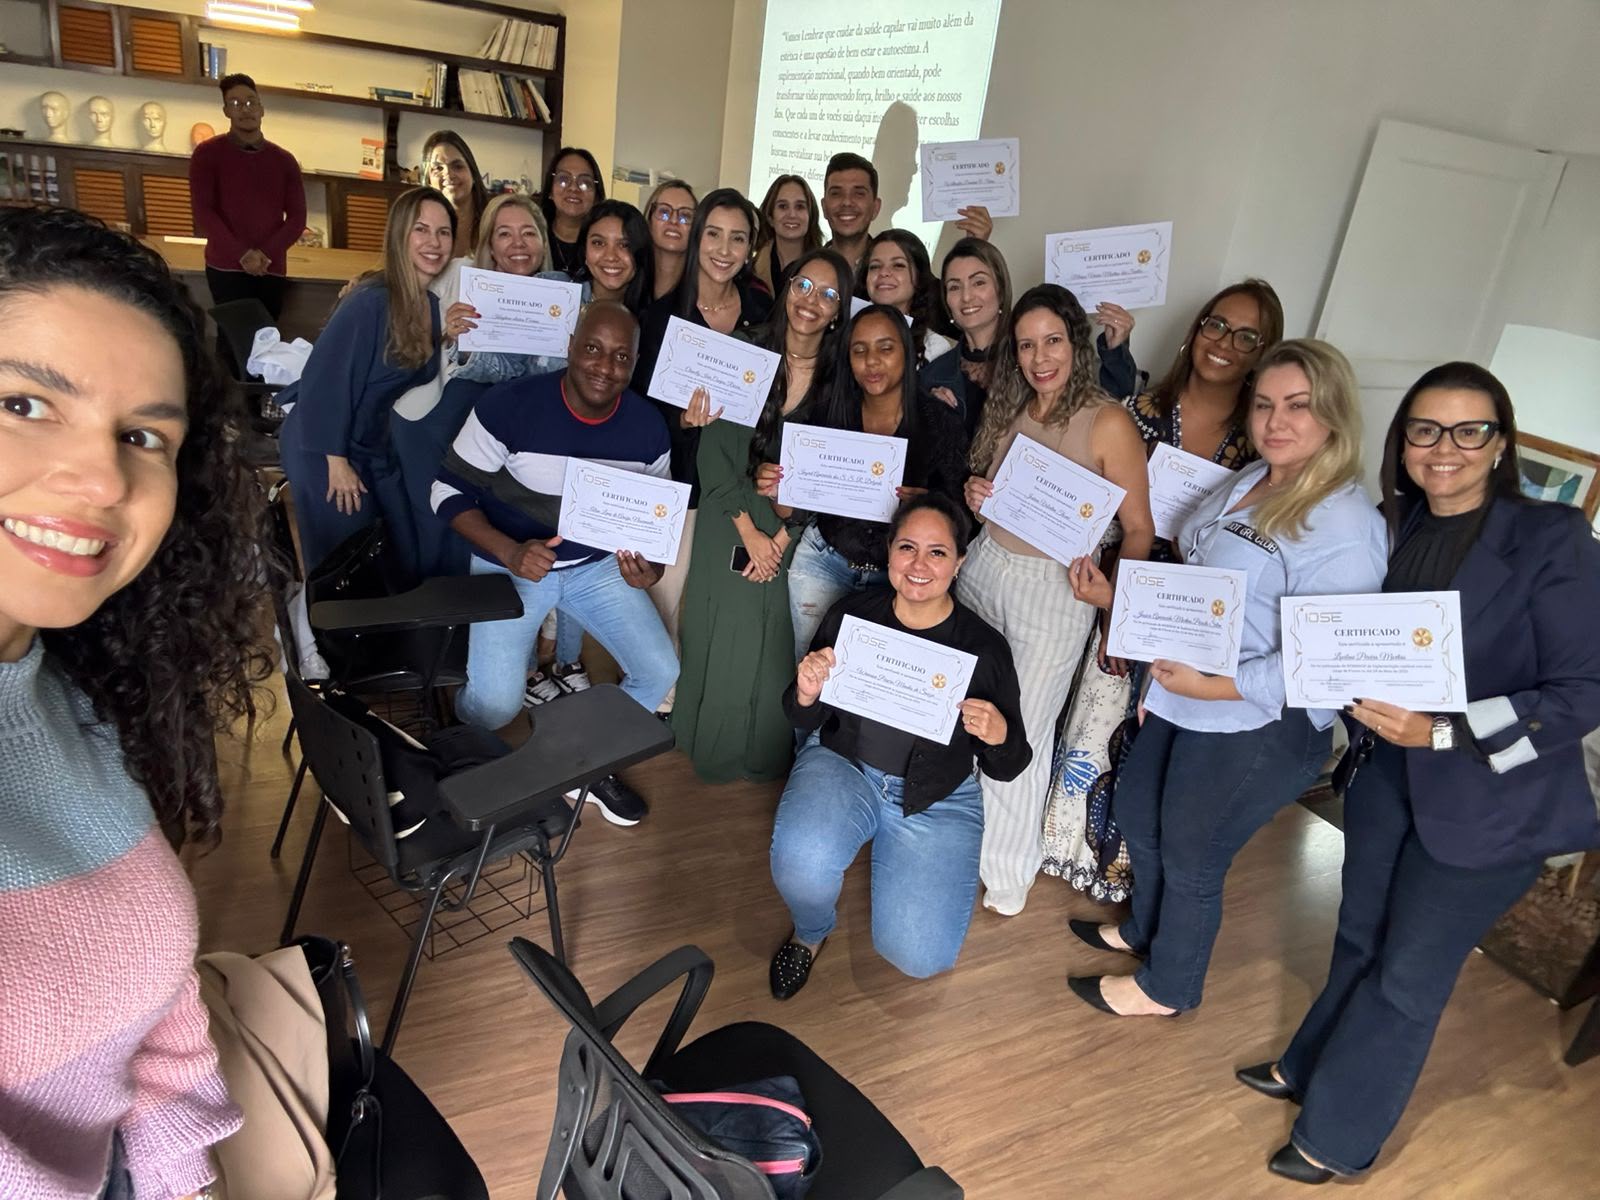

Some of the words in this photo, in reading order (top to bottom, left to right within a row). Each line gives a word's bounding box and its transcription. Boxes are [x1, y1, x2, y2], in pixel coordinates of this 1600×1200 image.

[825, 30, 836, 44] que
[855, 23, 863, 36] da
[864, 21, 882, 35] saúde
[883, 18, 906, 38] capilar
[907, 18, 918, 31] vai
[918, 17, 941, 30] muito
[942, 13, 962, 28] além
[963, 11, 974, 26] da
[816, 48, 836, 64] questão
[837, 46, 845, 58] de
[845, 45, 859, 57] bem
[860, 47, 876, 57] estar
[882, 43, 921, 55] autoestima.
[922, 40, 929, 53] A
[815, 67, 846, 81] nutricional,
[847, 66, 870, 84] quando
[871, 66, 885, 79] bem
[886, 64, 921, 79] orientada,
[922, 63, 942, 83] pode
[819, 88, 855, 105] promovendo
[856, 88, 873, 104] força,
[875, 88, 895, 101] brilho
[902, 88, 922, 101] saúde
[922, 93, 935, 102] aos
[937, 92, 962, 102] nossos
[785, 107, 796, 122] Que
[818, 109, 825, 120] de
[826, 108, 842, 121] vocês
[854, 110, 871, 127] daqui
[929, 112, 959, 126] escolhas
[808, 128, 821, 140] levar
[822, 130, 861, 144] conhecimento
[952, 162, 990, 170] CERTIFICADO
[1083, 251, 1131, 262] CERTIFICADO
[497, 298, 543, 308] CERTIFICADO
[697, 352, 739, 371] CERTIFICADO
[818, 453, 865, 465] CERTIFICADO
[1035, 475, 1078, 502] CERTIFICADO
[601, 491, 648, 507] CERTIFICADO
[1156, 592, 1205, 605] CERTIFICADO
[1334, 628, 1401, 637] CERTIFICADO
[876, 653, 926, 675] CERTIFICADO
